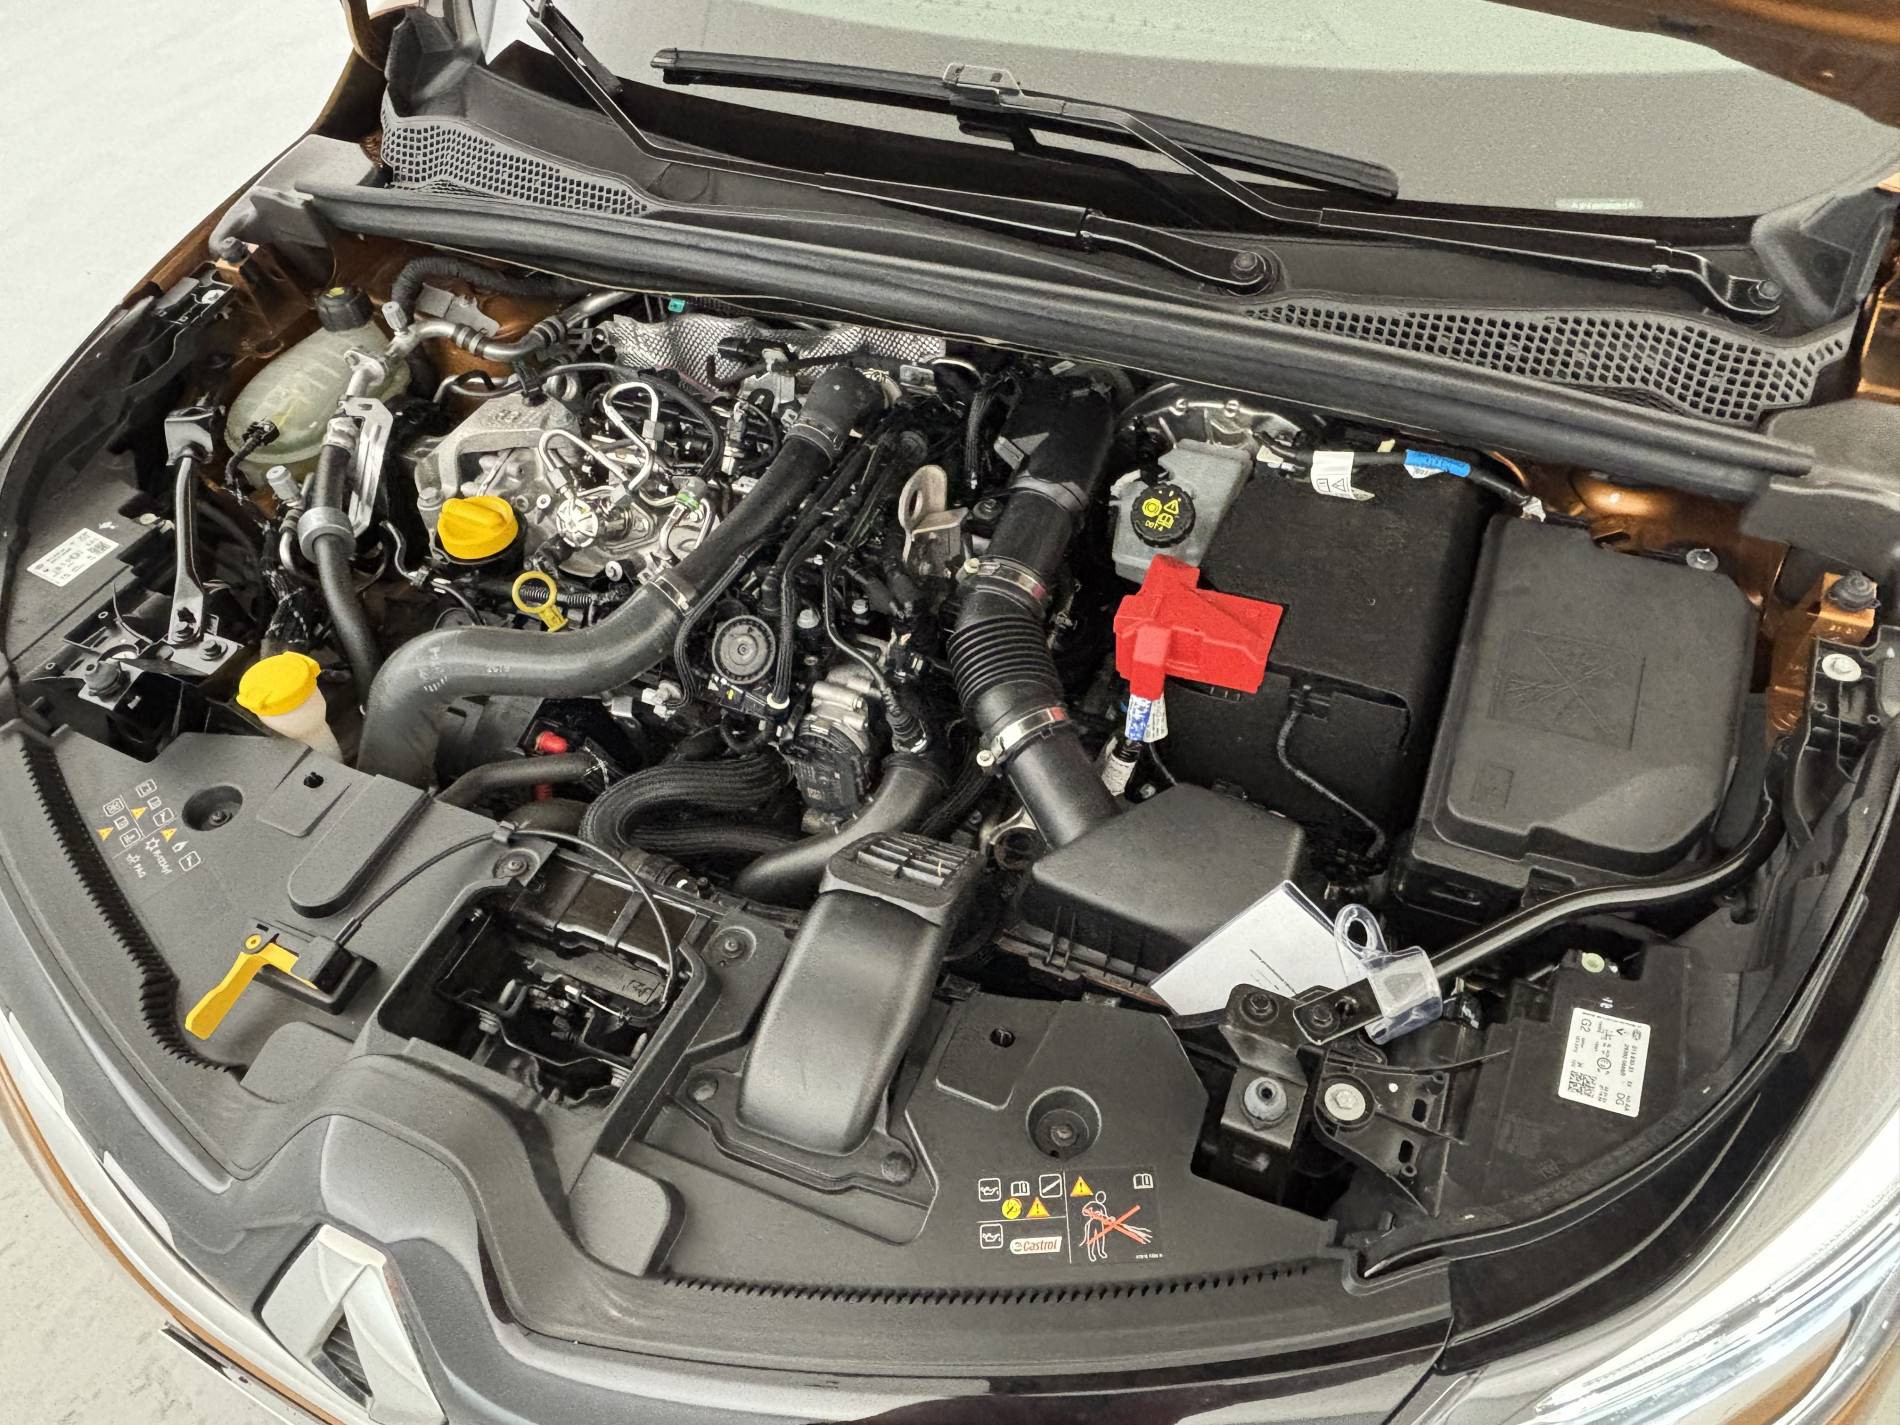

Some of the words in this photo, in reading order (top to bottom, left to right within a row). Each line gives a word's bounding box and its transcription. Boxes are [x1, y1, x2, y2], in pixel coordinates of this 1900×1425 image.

[1580, 1018, 1592, 1033] G2
[1615, 1092, 1626, 1106] DG
[1023, 1239, 1058, 1252] Castrol
